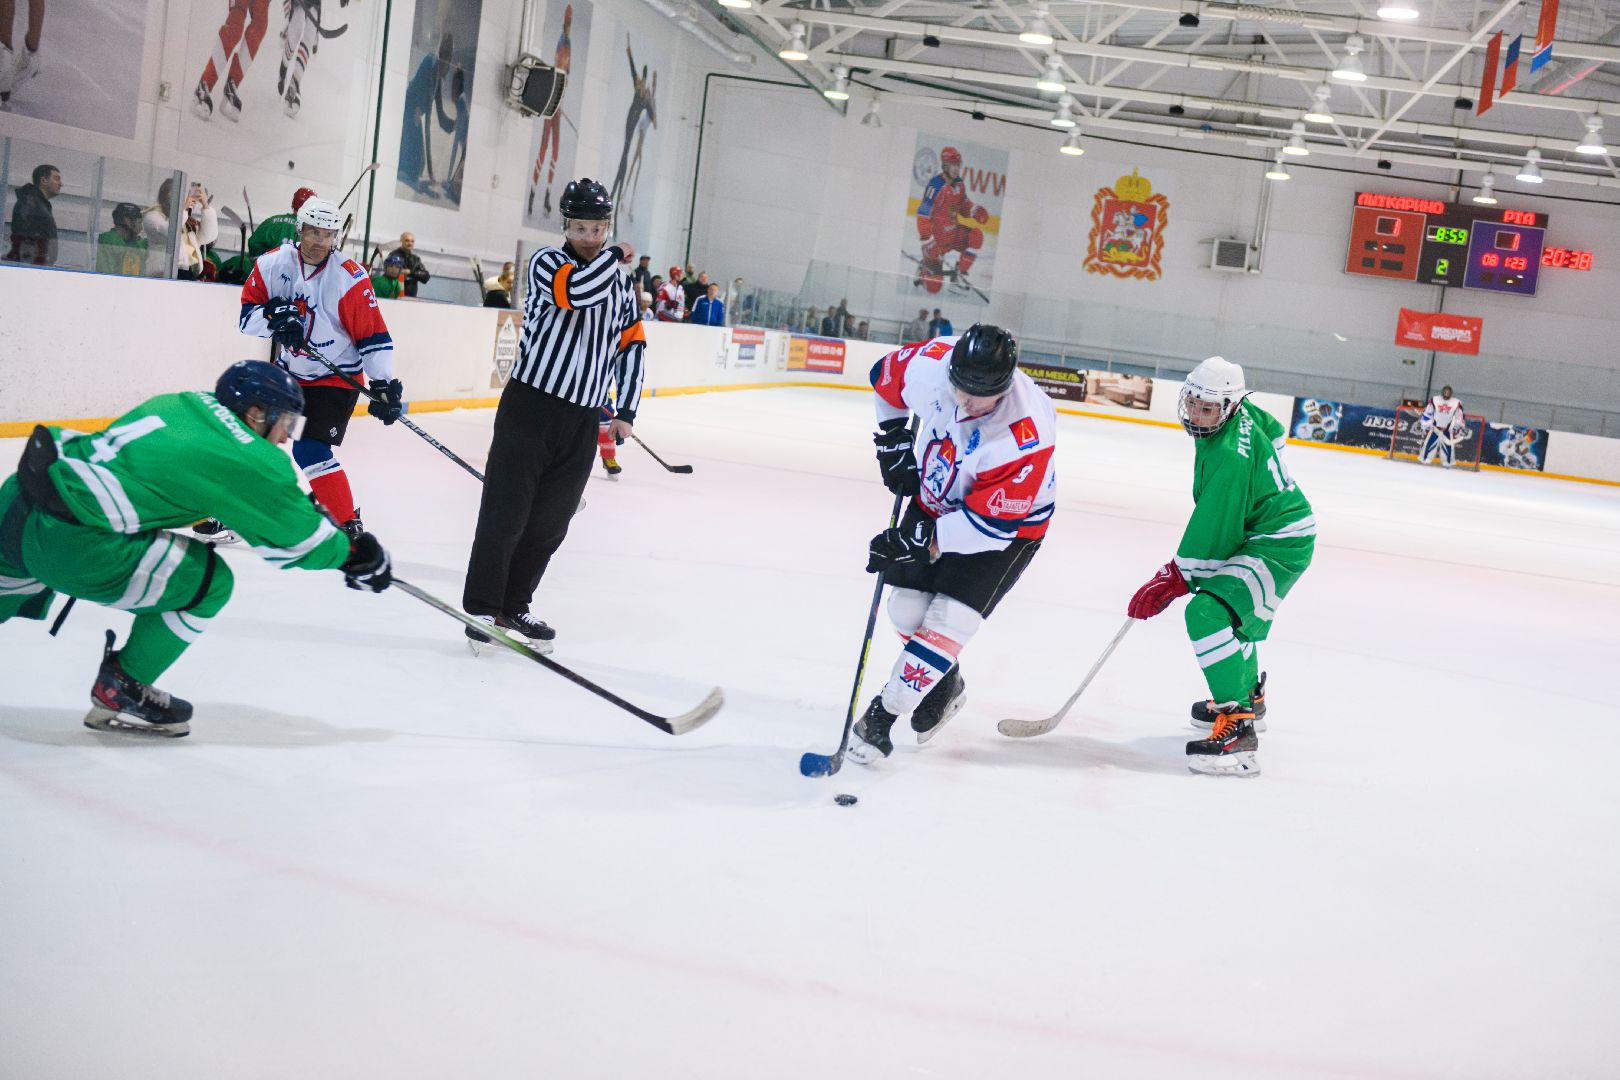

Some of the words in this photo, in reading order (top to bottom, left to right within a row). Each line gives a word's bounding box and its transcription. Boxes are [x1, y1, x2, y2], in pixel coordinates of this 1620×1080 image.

[1357, 192, 1445, 215] ЛЫТКАРИНО
[1436, 227, 1467, 245] 8:59
[1436, 259, 1448, 275] 2
[1482, 253, 1499, 267] 08
[1541, 247, 1594, 271] 20:38
[1012, 464, 1034, 484] 9
